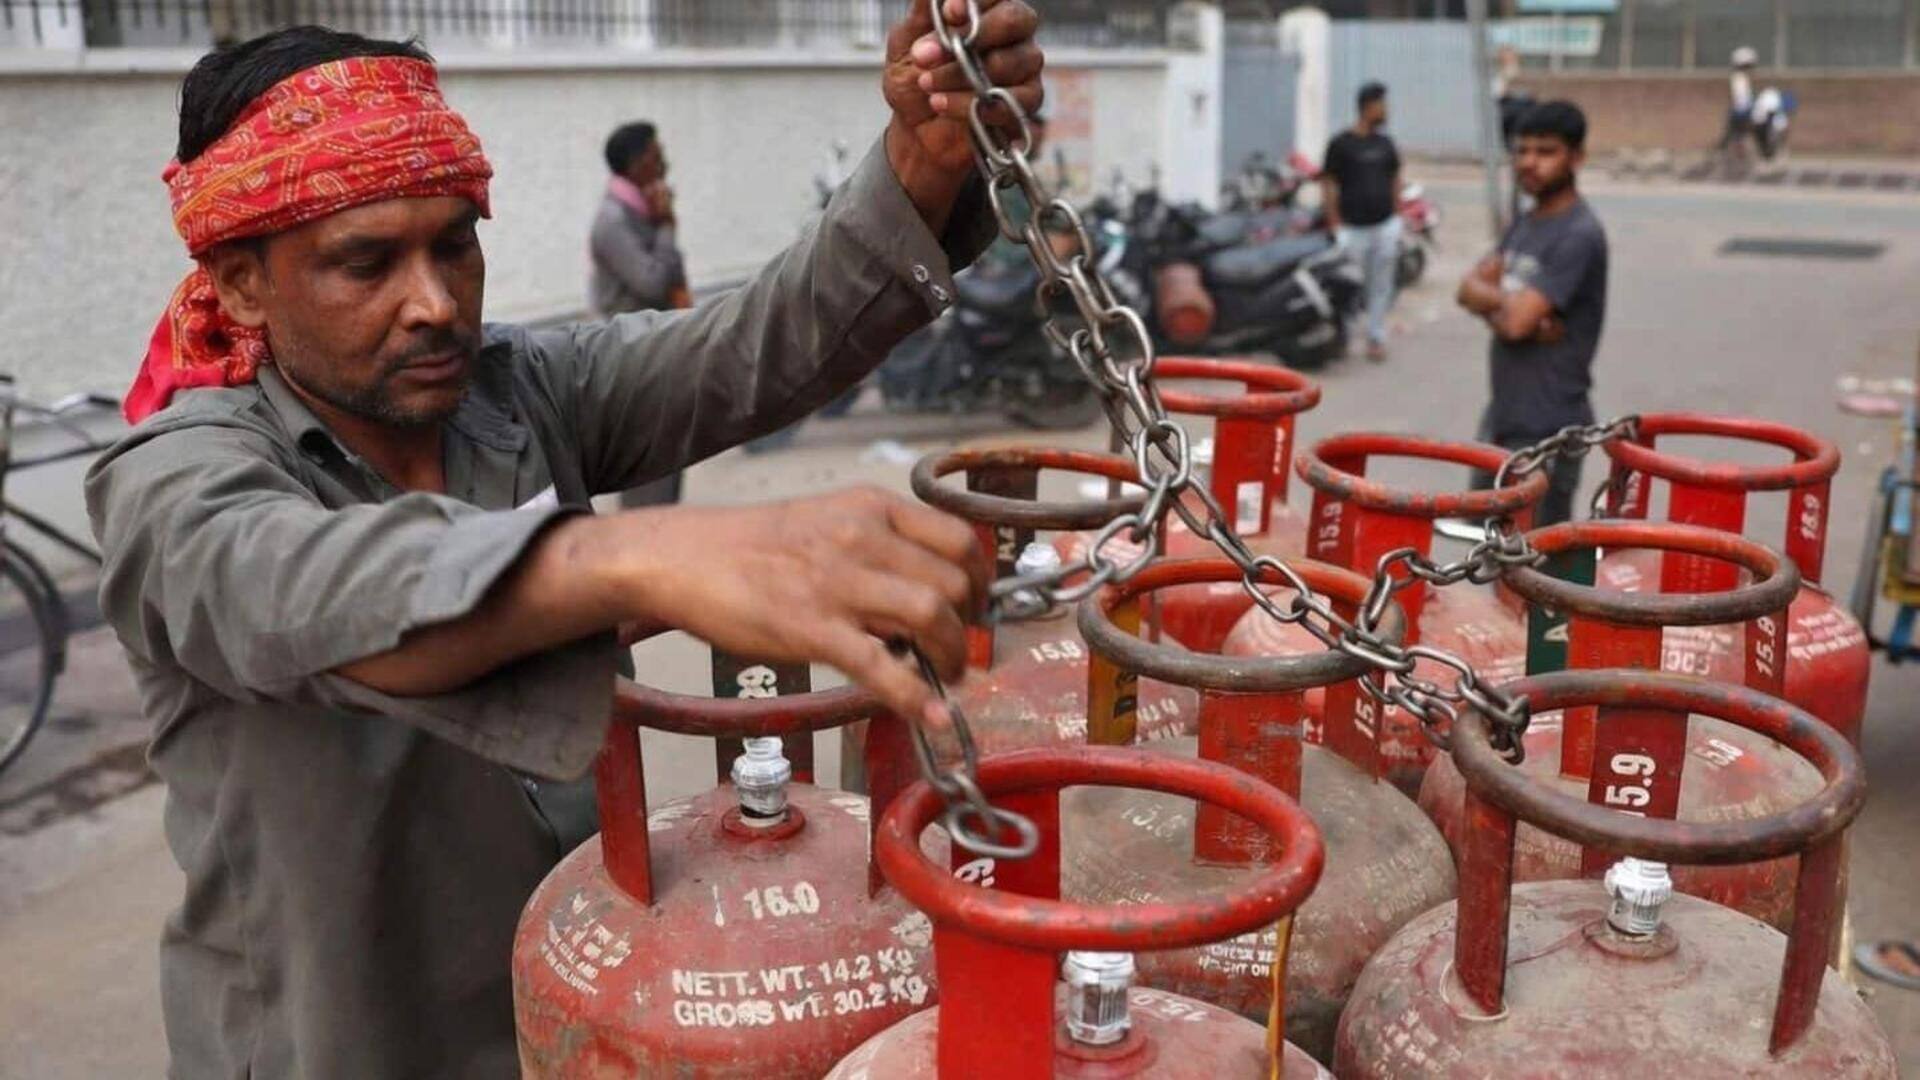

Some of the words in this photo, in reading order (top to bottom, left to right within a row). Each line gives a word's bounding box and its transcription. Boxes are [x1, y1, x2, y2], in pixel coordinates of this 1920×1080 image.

[743, 881, 820, 920] 16.0
[818, 955, 873, 985] 14.2
[833, 984, 886, 1016] 30.2
